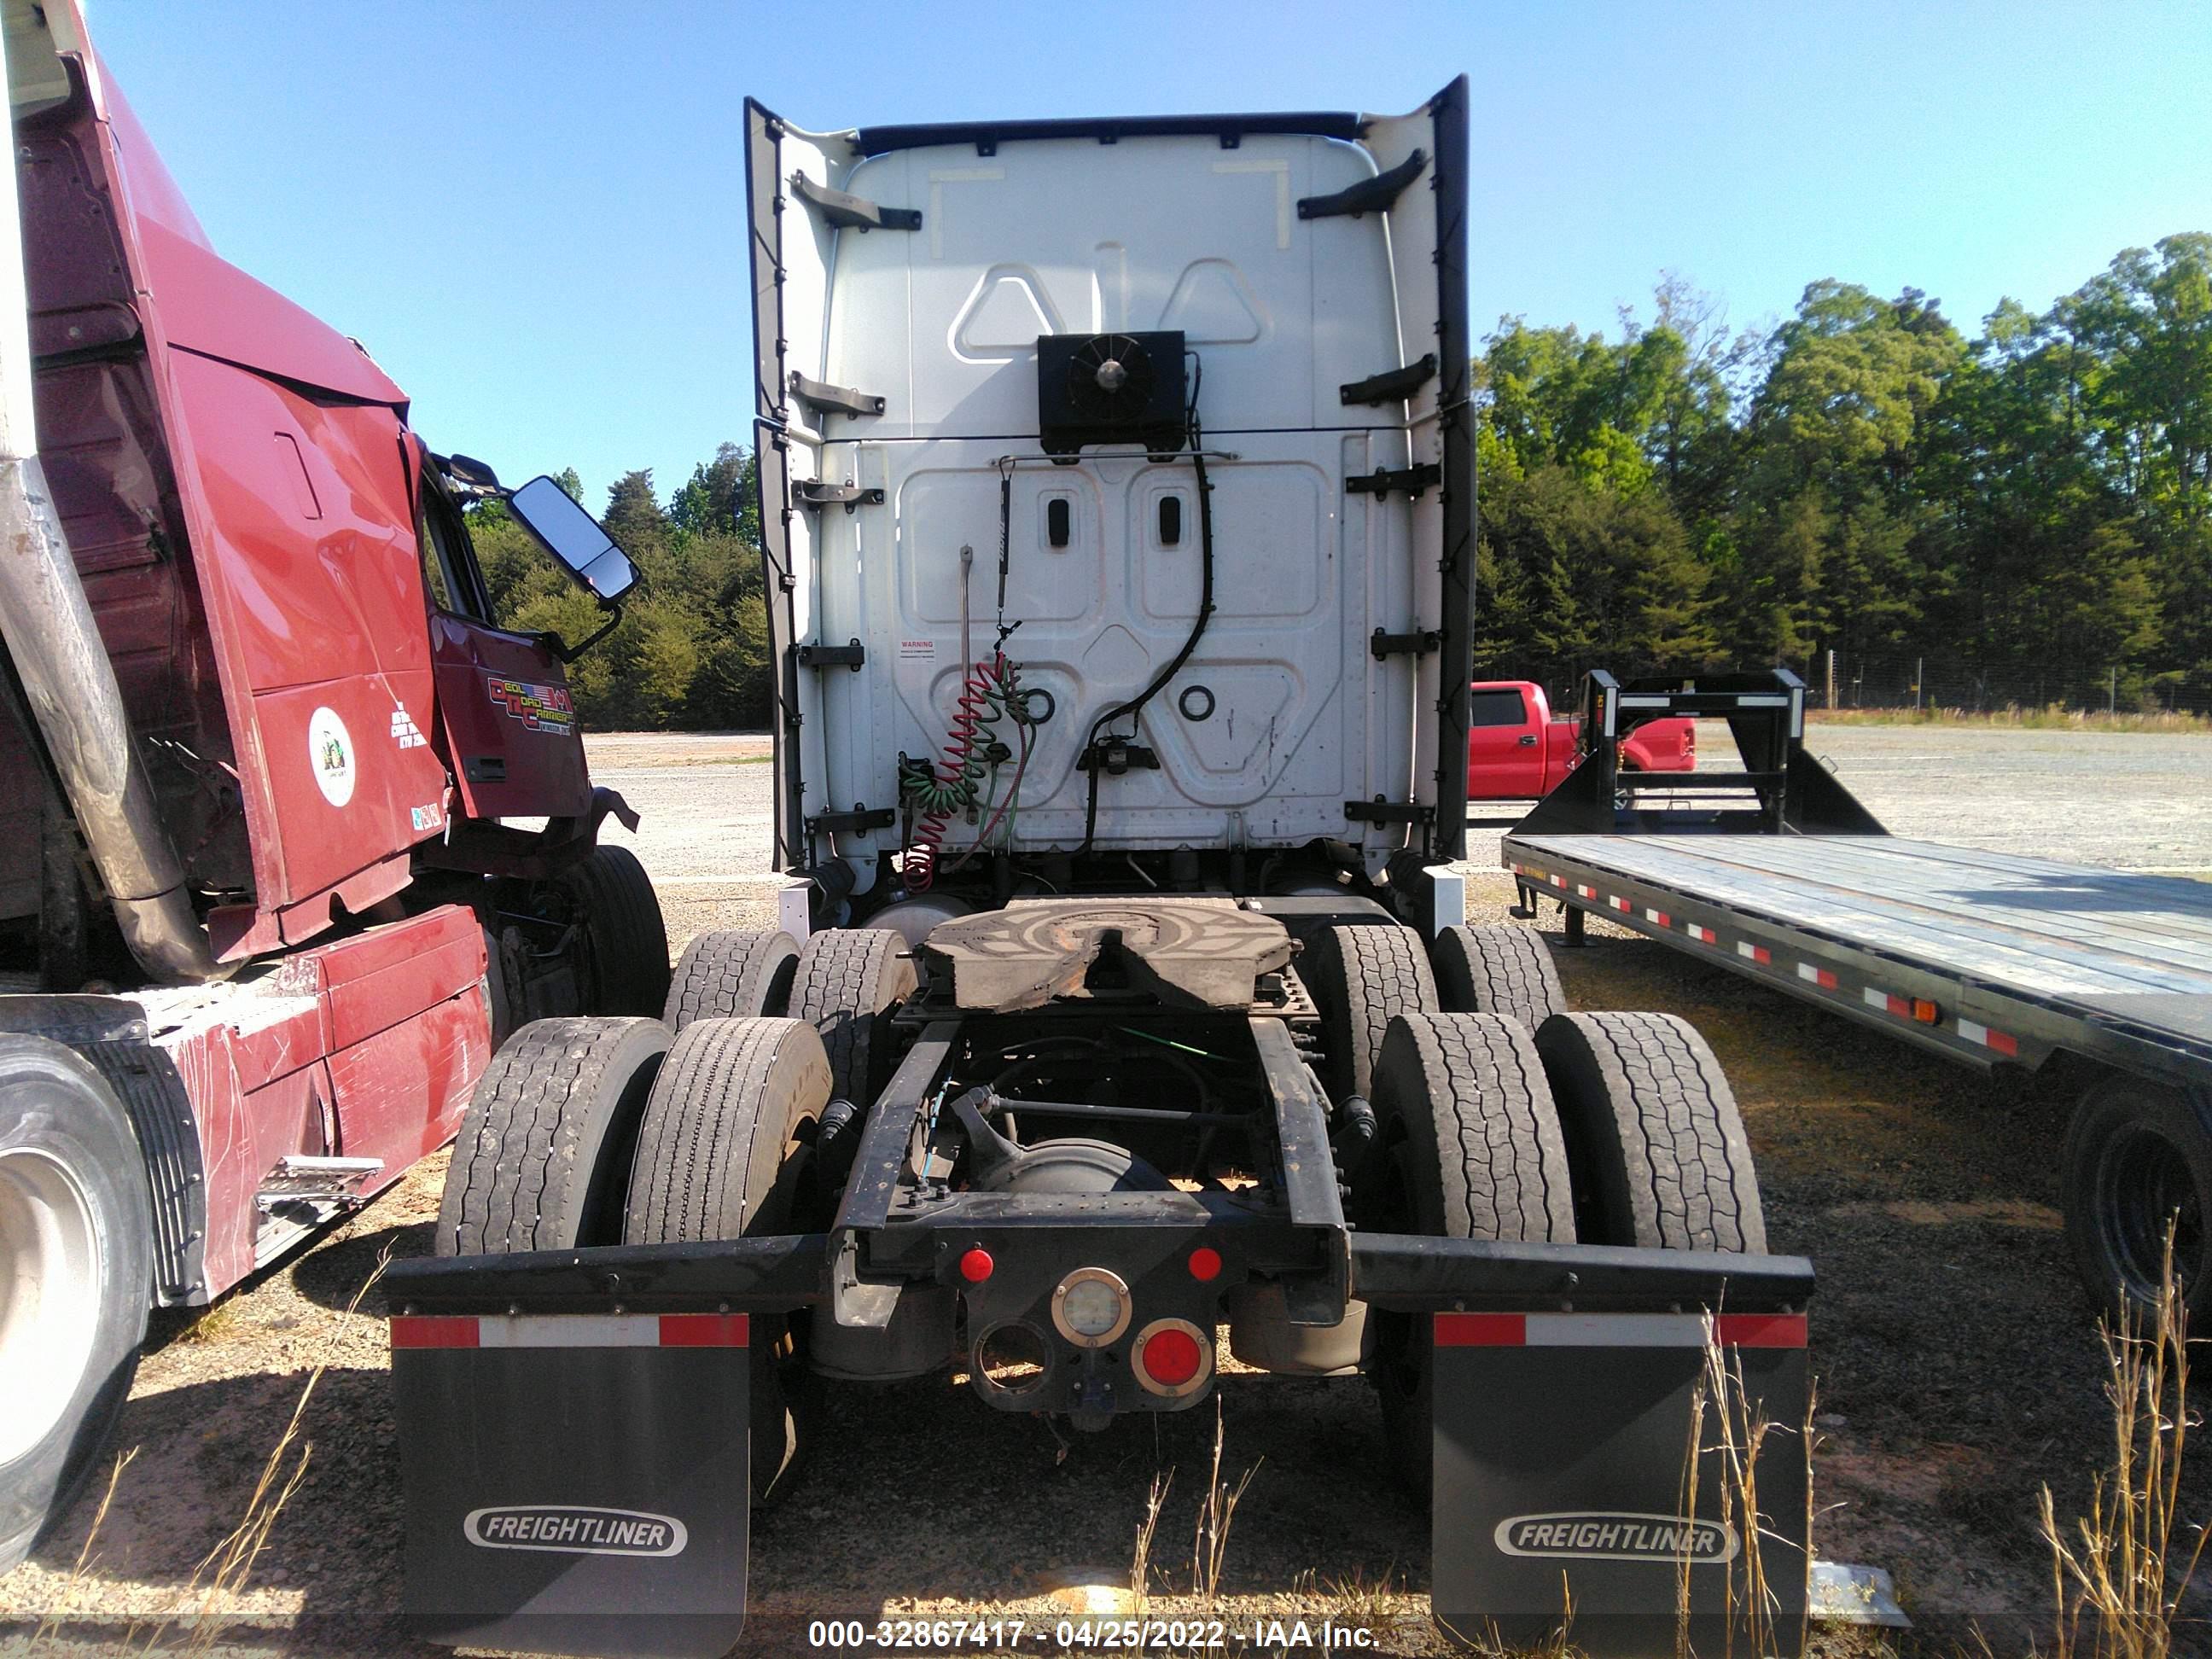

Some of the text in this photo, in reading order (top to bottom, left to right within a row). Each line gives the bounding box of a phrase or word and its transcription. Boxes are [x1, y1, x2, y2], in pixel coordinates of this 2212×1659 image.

[507, 695, 542, 714] ROAD
[523, 707, 568, 725] CARRIER
[486, 1516, 667, 1546] FREIGHTLINER
[1517, 1522, 1716, 1553] FREIGHTLINER
